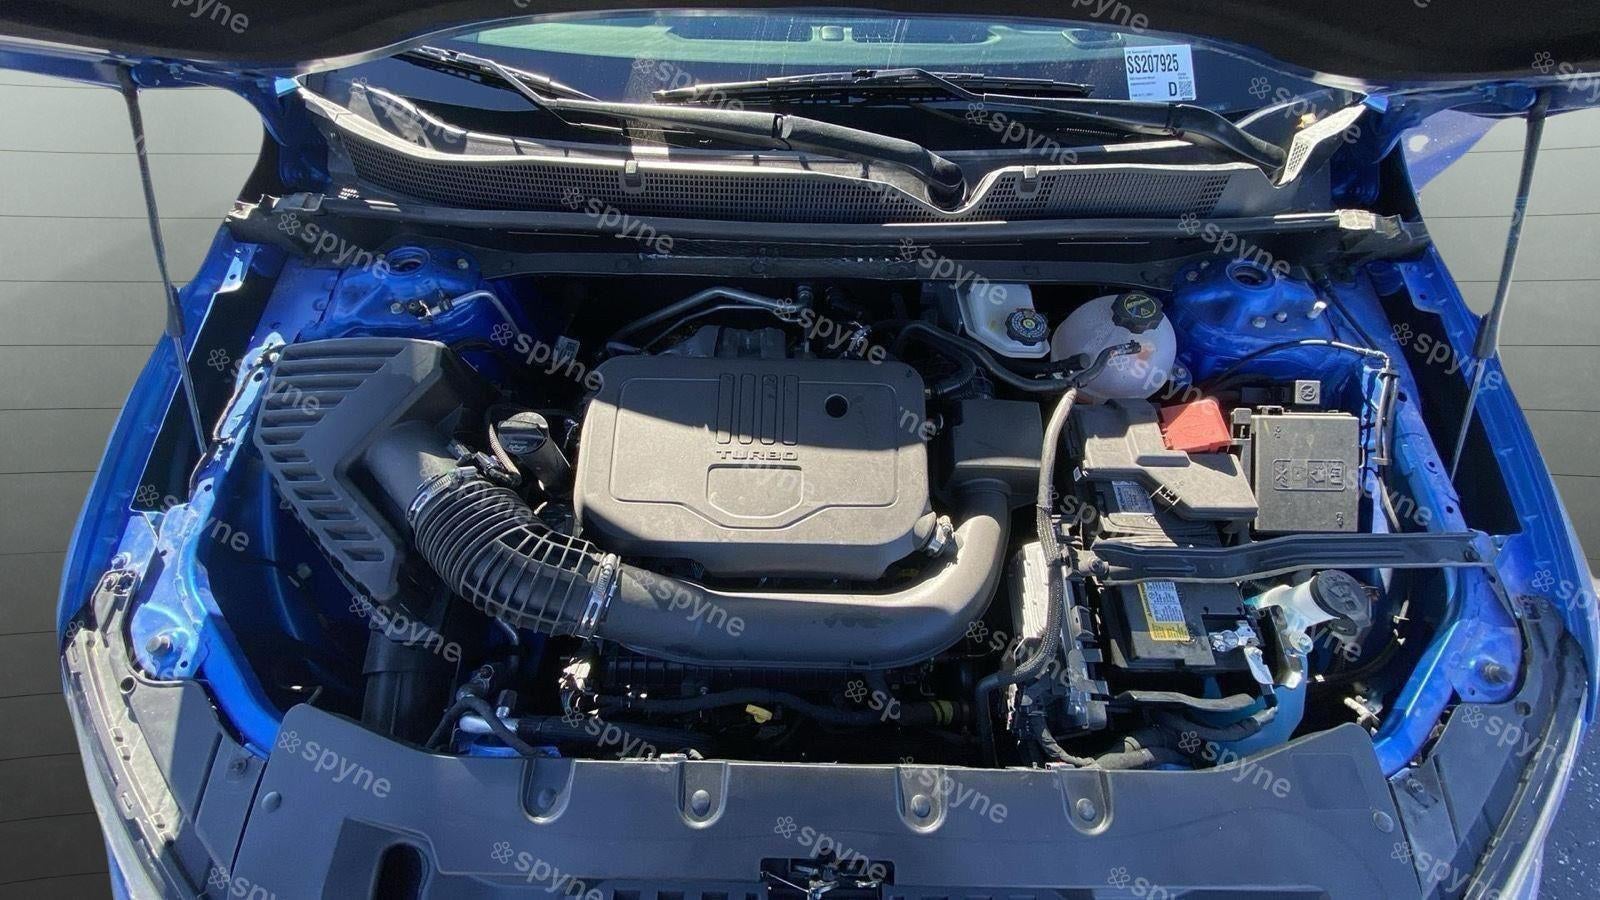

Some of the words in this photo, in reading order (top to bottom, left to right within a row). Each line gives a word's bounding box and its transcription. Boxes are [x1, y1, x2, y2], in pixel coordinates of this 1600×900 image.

[1126, 53, 1179, 74] SS207925
[1168, 81, 1178, 97] D
[716, 451, 799, 461] TURBO
